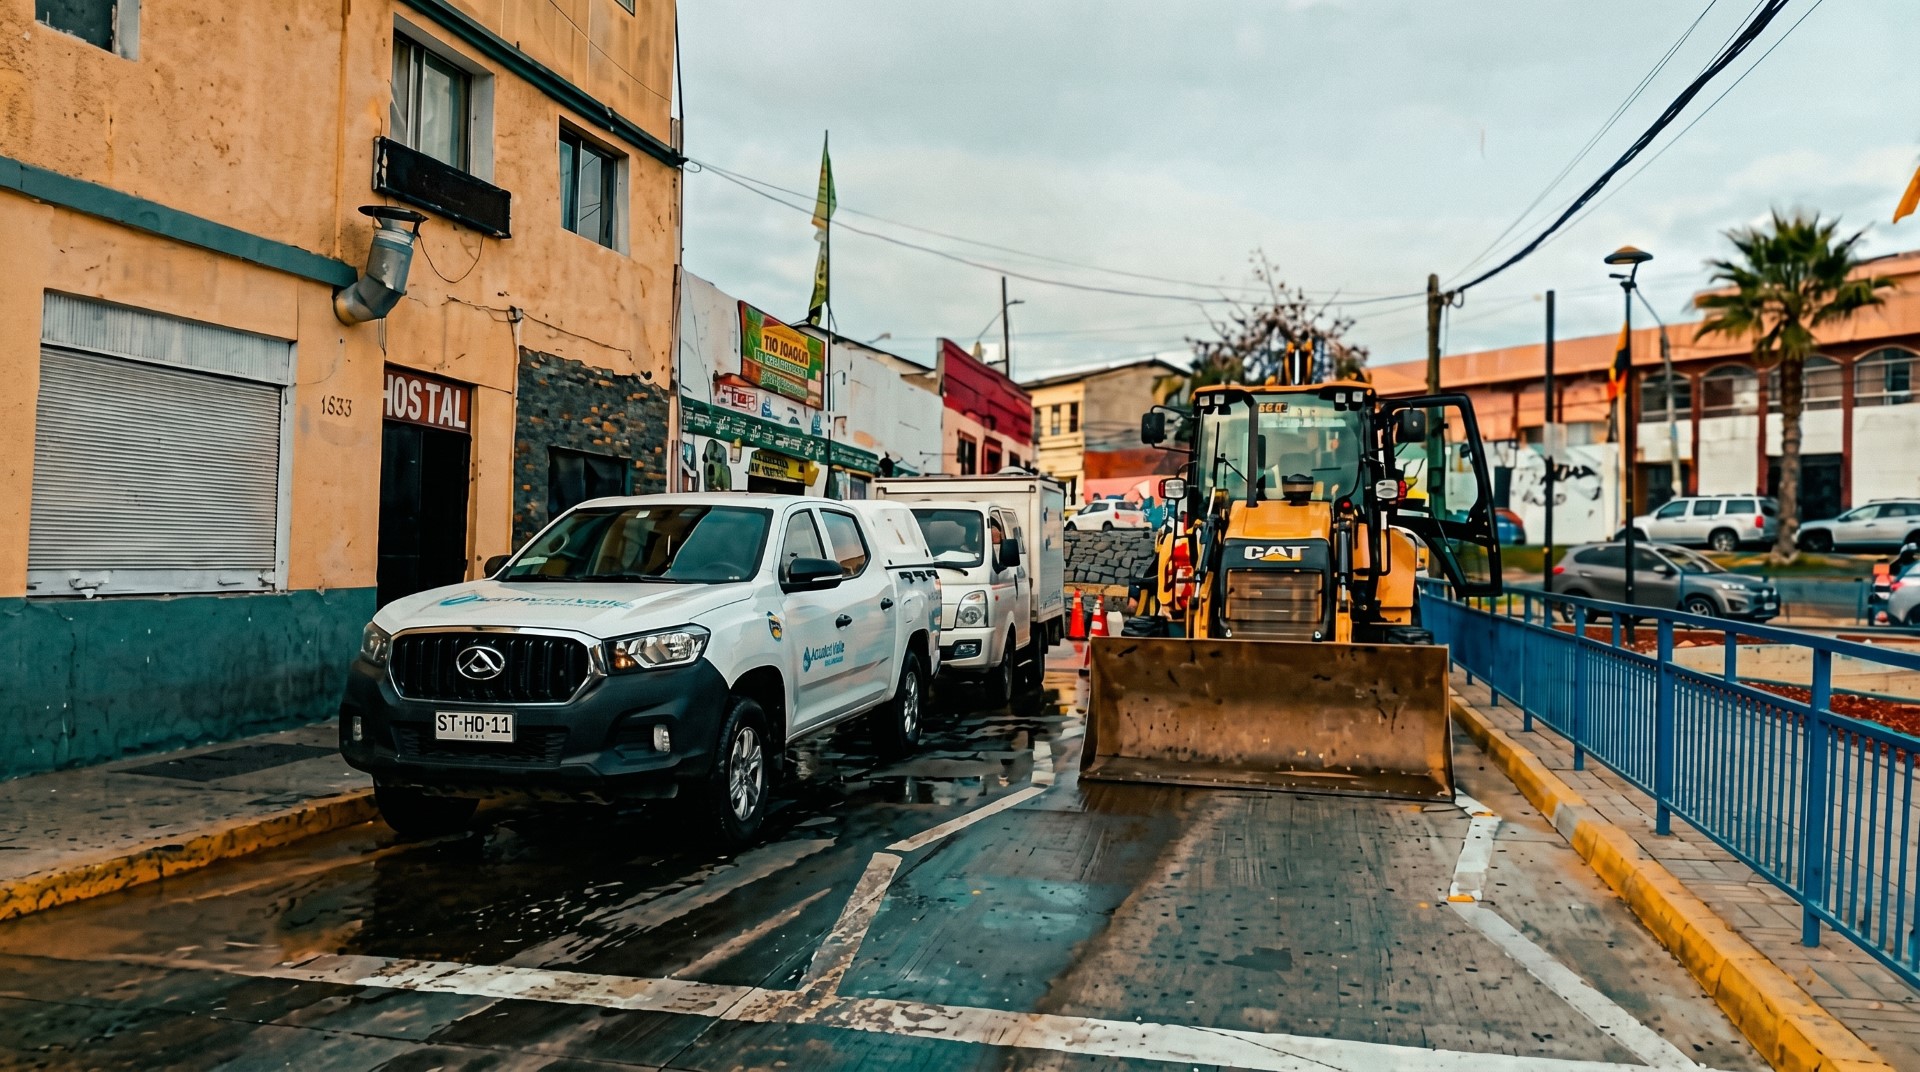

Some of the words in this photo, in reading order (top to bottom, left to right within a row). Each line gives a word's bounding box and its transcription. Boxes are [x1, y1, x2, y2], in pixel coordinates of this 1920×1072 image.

[764, 335, 778, 353] TIO
[383, 374, 466, 428] HOSTAL
[1244, 545, 1310, 562] CAT
